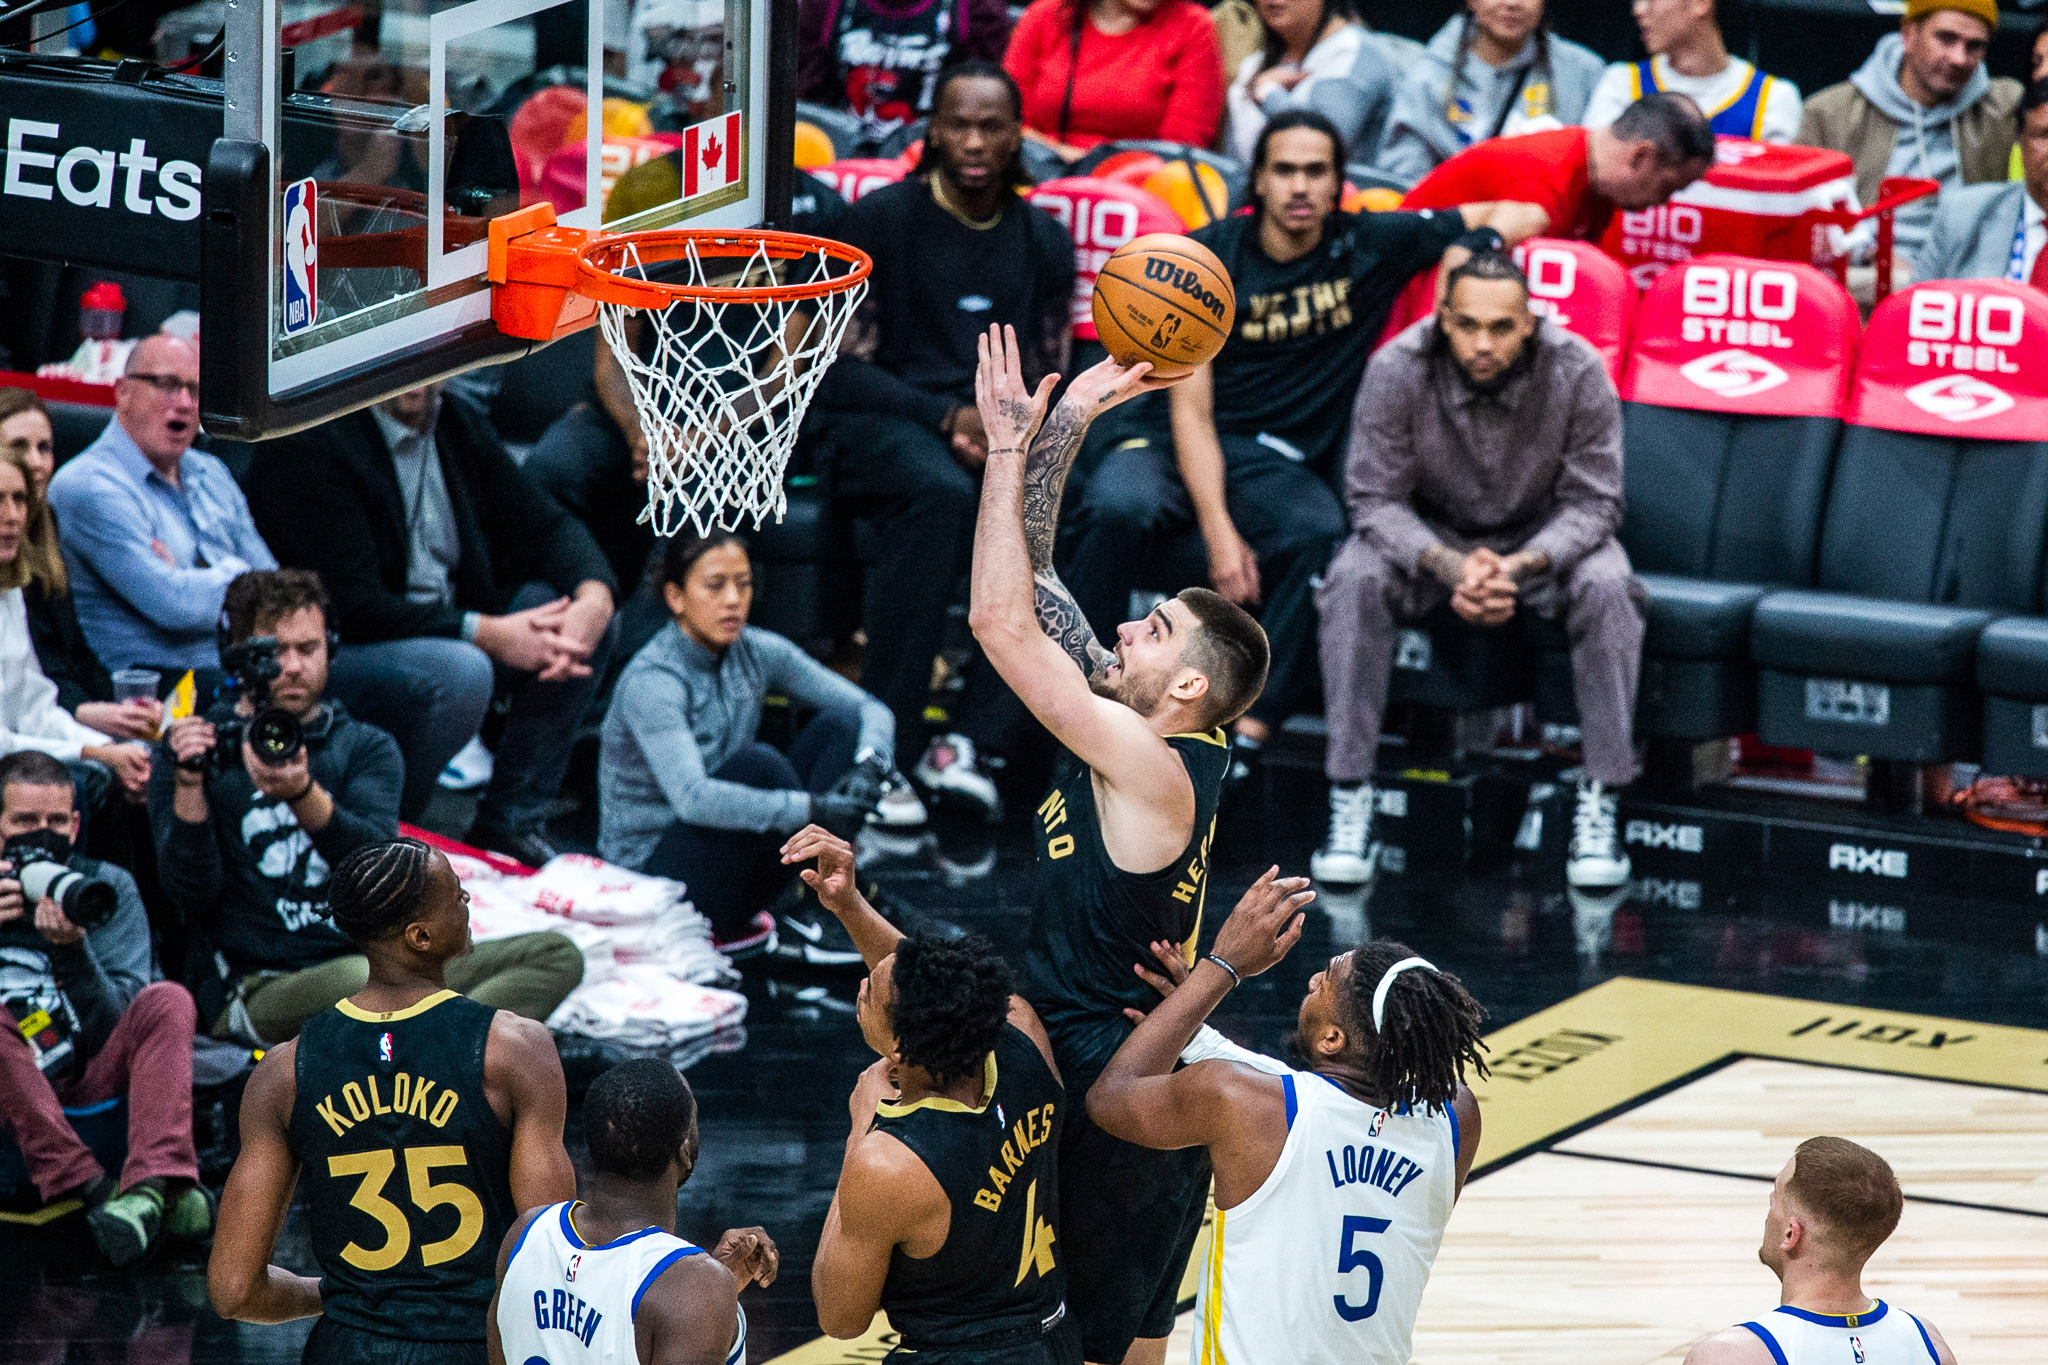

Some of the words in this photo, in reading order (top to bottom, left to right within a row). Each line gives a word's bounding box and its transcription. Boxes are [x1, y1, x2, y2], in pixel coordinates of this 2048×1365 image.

[3, 118, 202, 221] Eats
[1621, 207, 1702, 244] BIO
[288, 298, 305, 326] NBA
[1143, 256, 1225, 322] Wilson
[1683, 266, 1798, 321] BIO
[1682, 316, 1793, 348] STEEL
[1908, 290, 2024, 346] BIO
[1907, 340, 2020, 374] STEEL
[1625, 819, 1704, 853] AXE
[1829, 843, 1908, 878] AXE
[315, 1072, 459, 1137] KOLOKO
[973, 1103, 1054, 1212] BARNES
[1326, 1145, 1424, 1198] LOONEY
[327, 1145, 484, 1271] 35
[1014, 1178, 1056, 1288] 4
[1333, 1215, 1392, 1322] 5
[533, 1288, 603, 1349] GREEN
